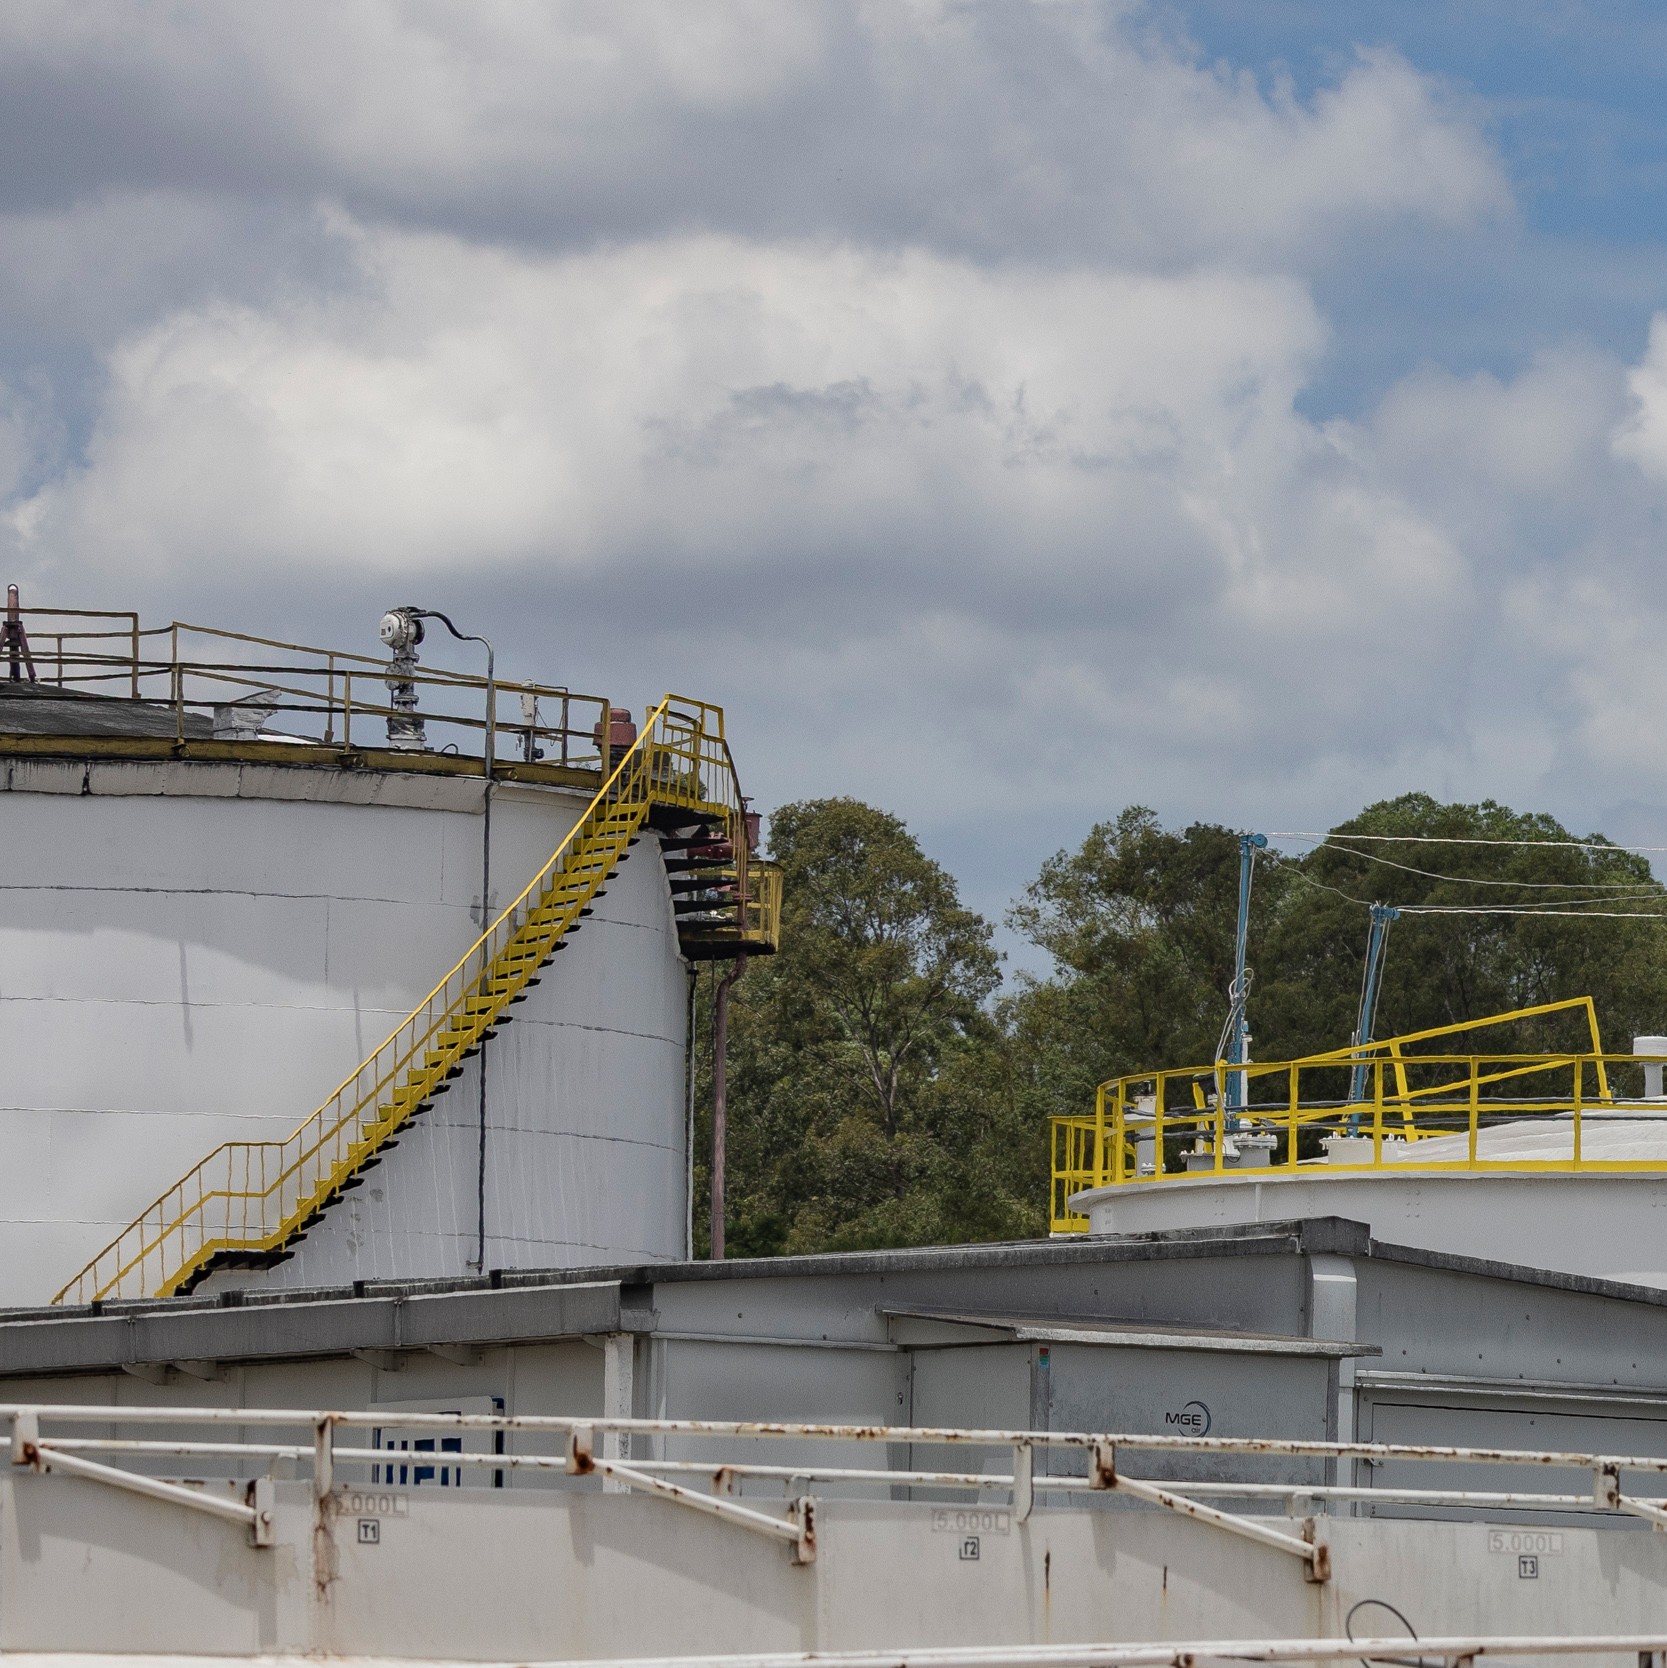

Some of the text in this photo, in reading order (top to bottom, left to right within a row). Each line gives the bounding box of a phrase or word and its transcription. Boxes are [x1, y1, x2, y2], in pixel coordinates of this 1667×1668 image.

[1165, 1412, 1201, 1426] MGE
[360, 1522, 378, 1540] T1
[1520, 1558, 1537, 1575] T3
